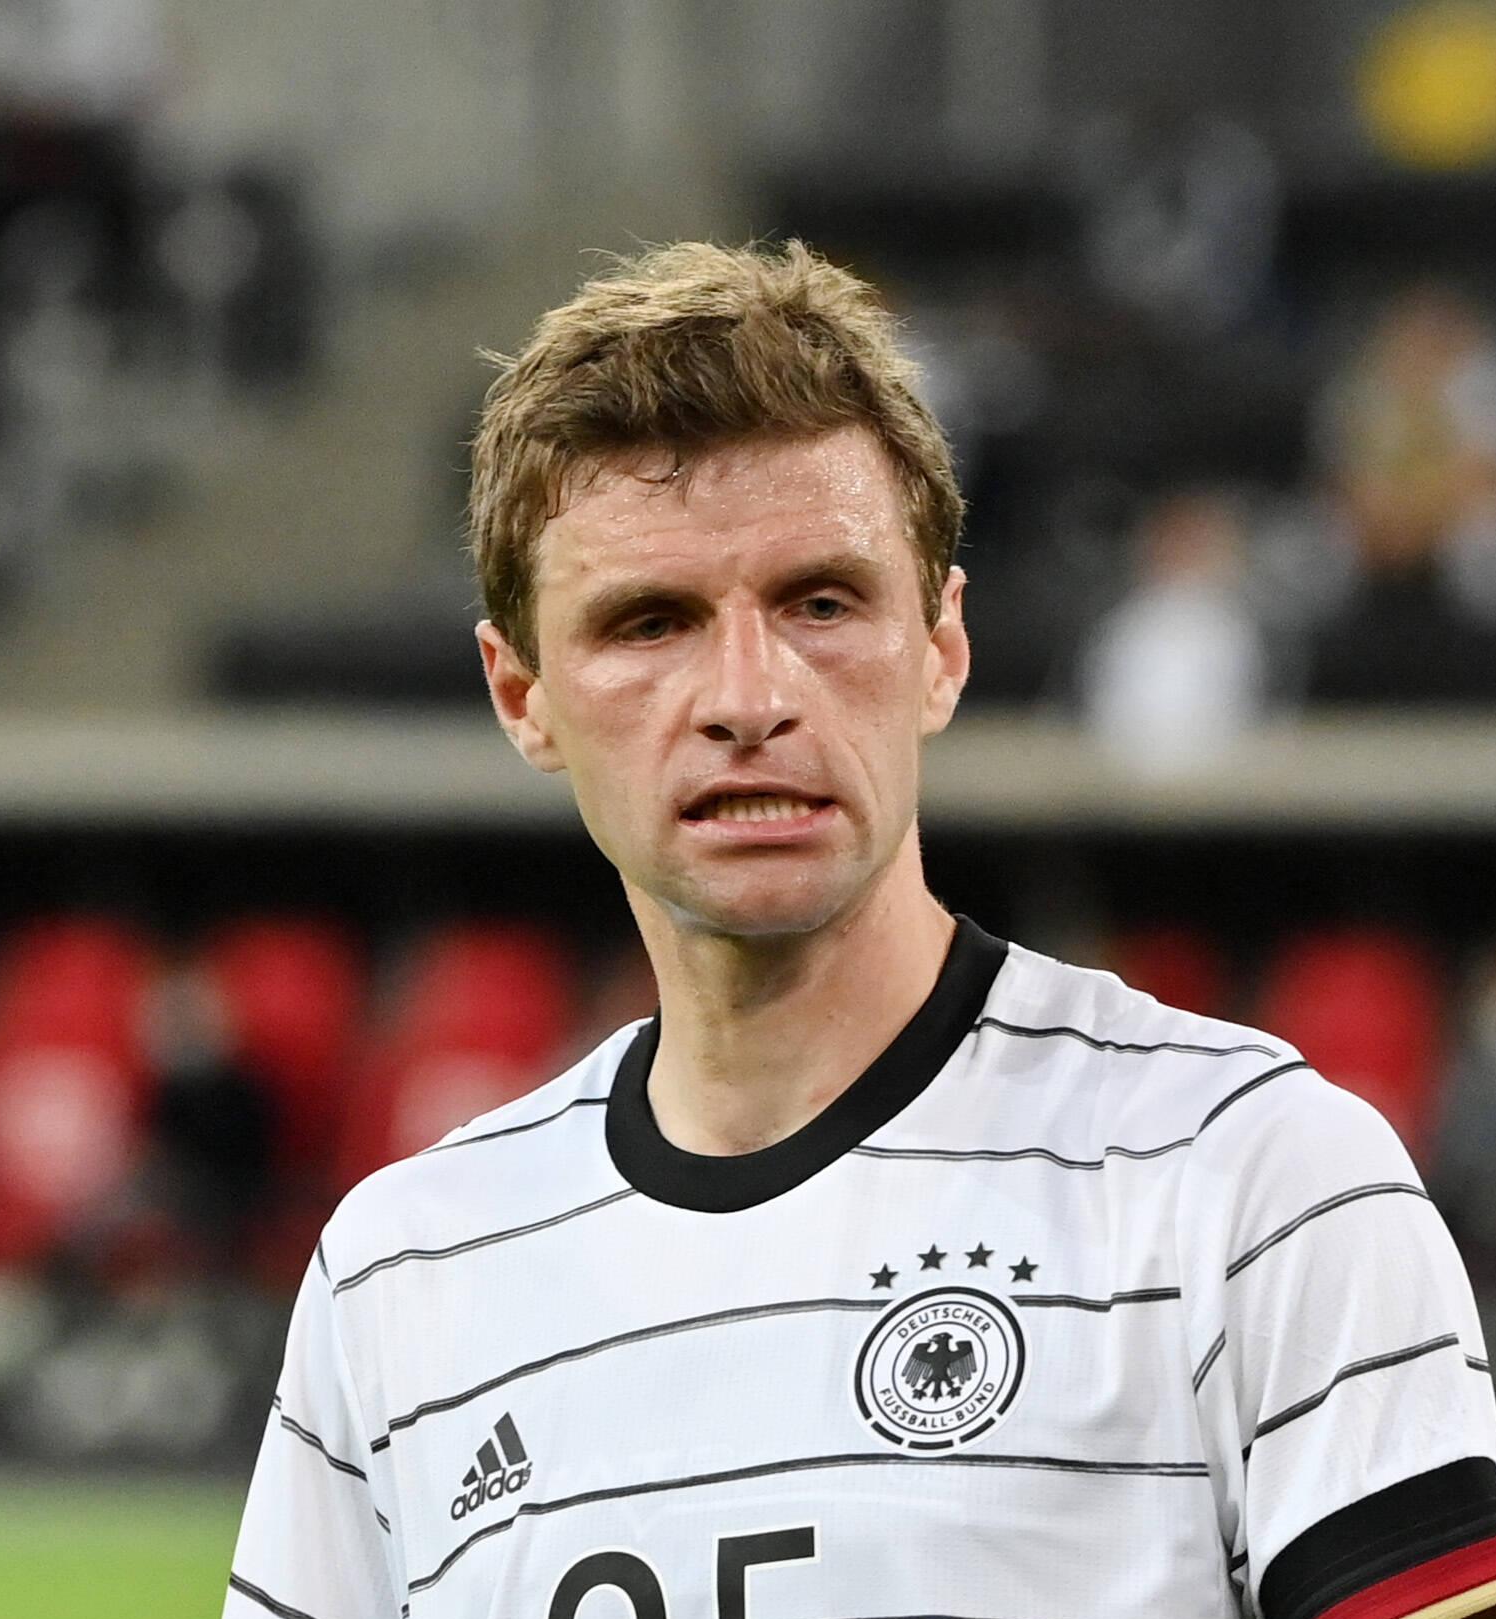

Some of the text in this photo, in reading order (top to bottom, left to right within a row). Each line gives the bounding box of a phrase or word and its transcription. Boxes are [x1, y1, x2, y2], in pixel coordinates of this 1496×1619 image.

[897, 1307, 991, 1339] DEUTSCHER
[879, 1382, 995, 1428] FUSSBALL-BUND
[450, 1460, 533, 1520] adidas
